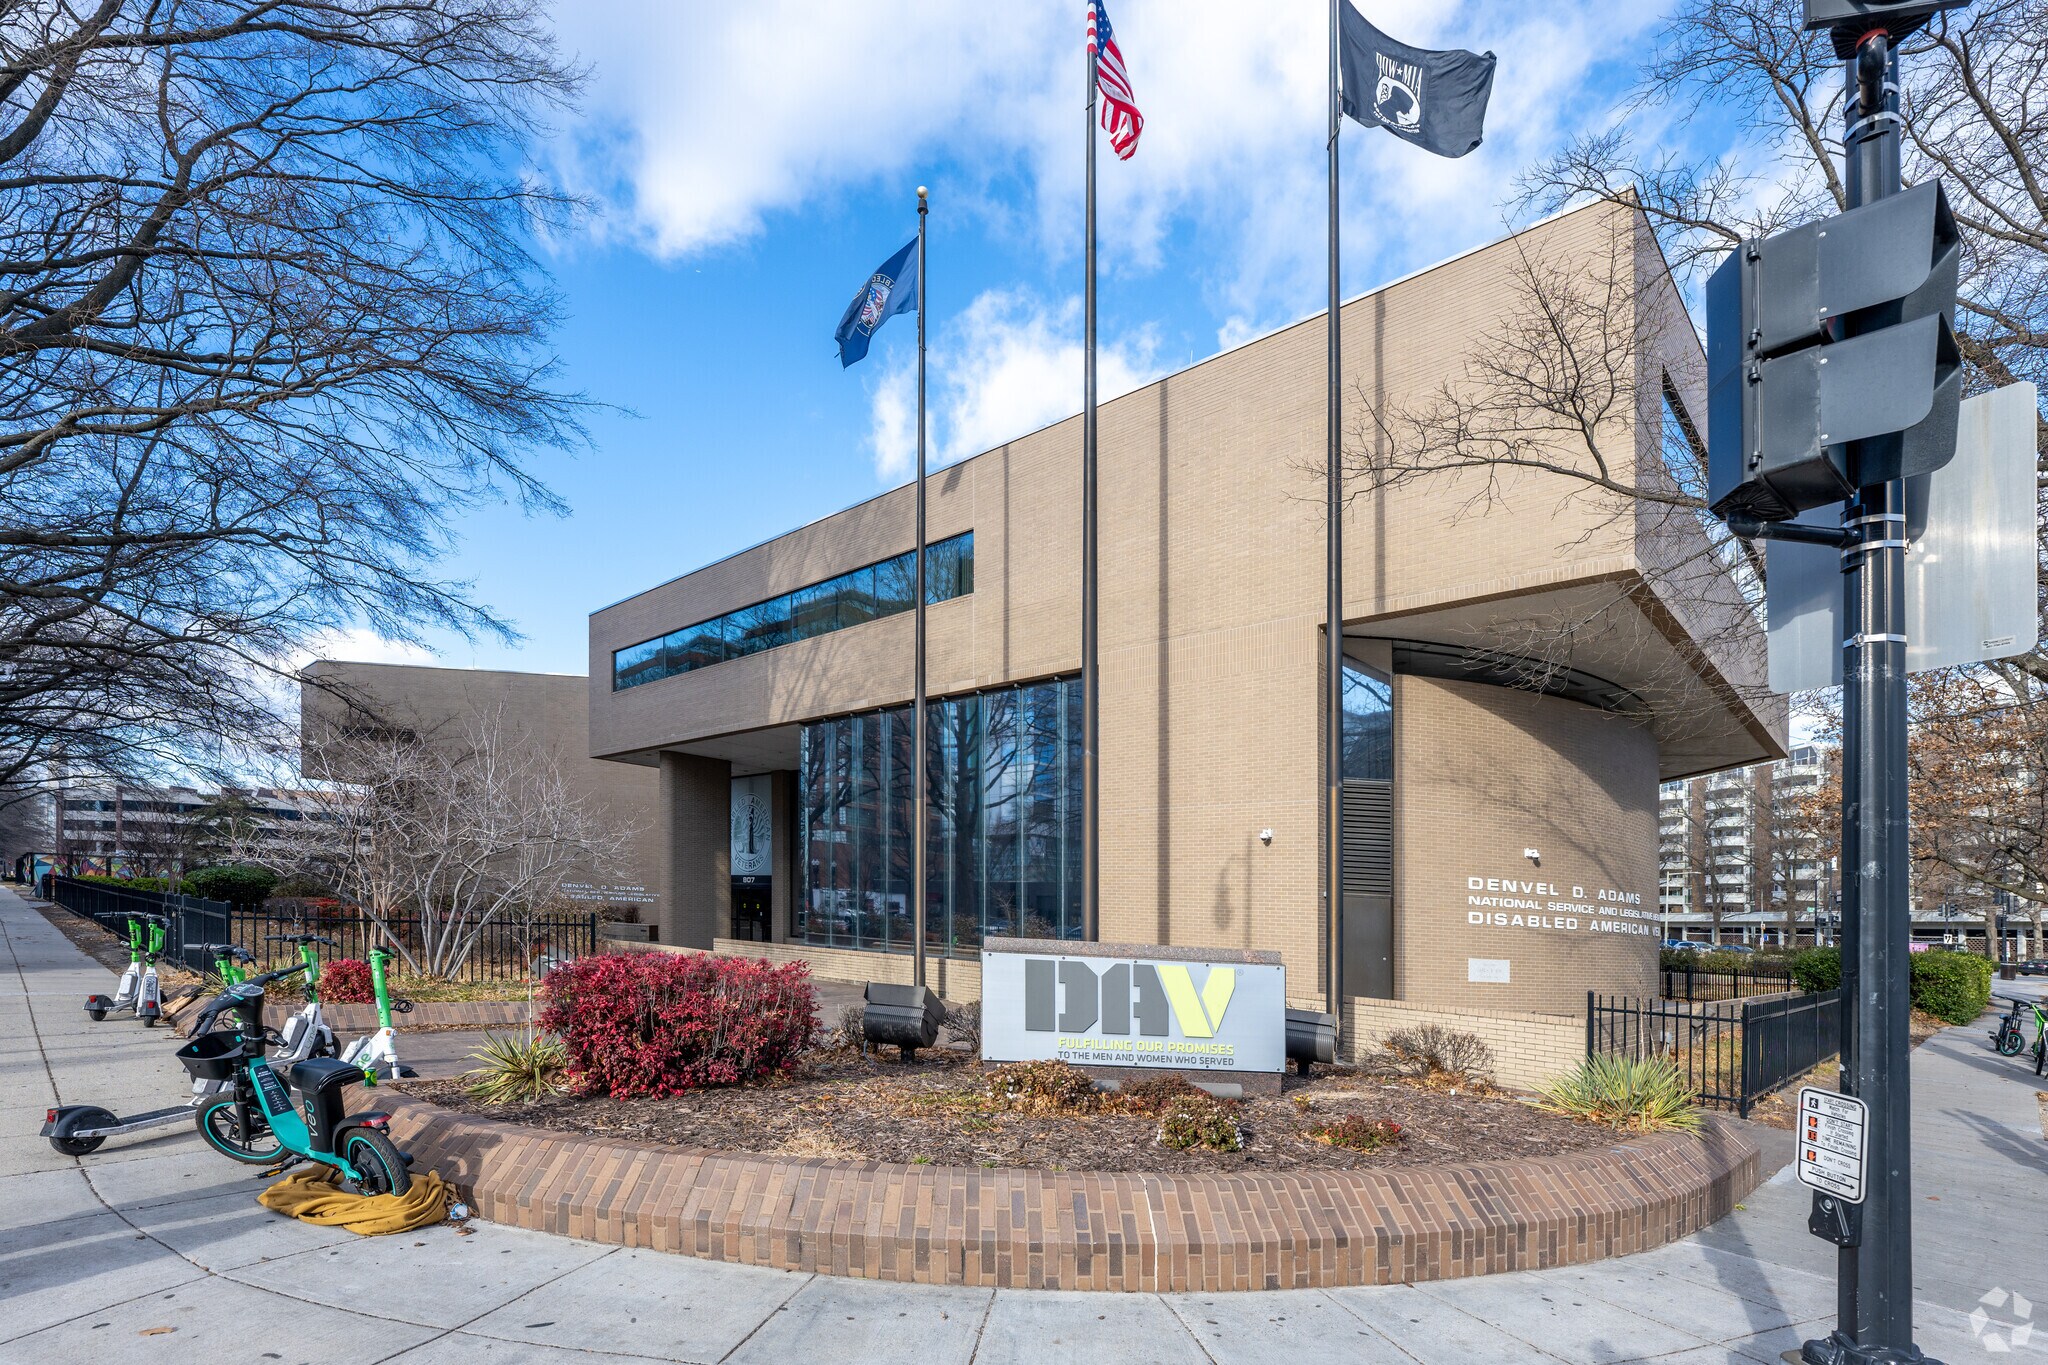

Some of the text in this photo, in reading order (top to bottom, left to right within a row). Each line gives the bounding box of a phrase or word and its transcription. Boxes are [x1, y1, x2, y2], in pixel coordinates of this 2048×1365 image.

[1376, 51, 1423, 103] POW MIA
[734, 854, 764, 870] VETERANS
[1468, 877, 1641, 905] DENVEL D. ADAMS
[1468, 896, 1542, 910] NATIONAL
[1547, 902, 1595, 914] SERVICE
[1598, 906, 1618, 917] AND
[1468, 911, 1578, 930] DISABLED
[1589, 919, 1649, 936] AMERICAN
[1058, 1037, 1234, 1056] FULFILLING OUR PROMISES
[1058, 1050, 1234, 1066] TO THE MEN AND WOMEN WHO SERVED
[1833, 1138, 1857, 1150] REMAINING
[1838, 1160, 1850, 1168] CROSS
[1826, 1171, 1847, 1182] BUTTON
[1824, 1180, 1841, 1190] CROSS
